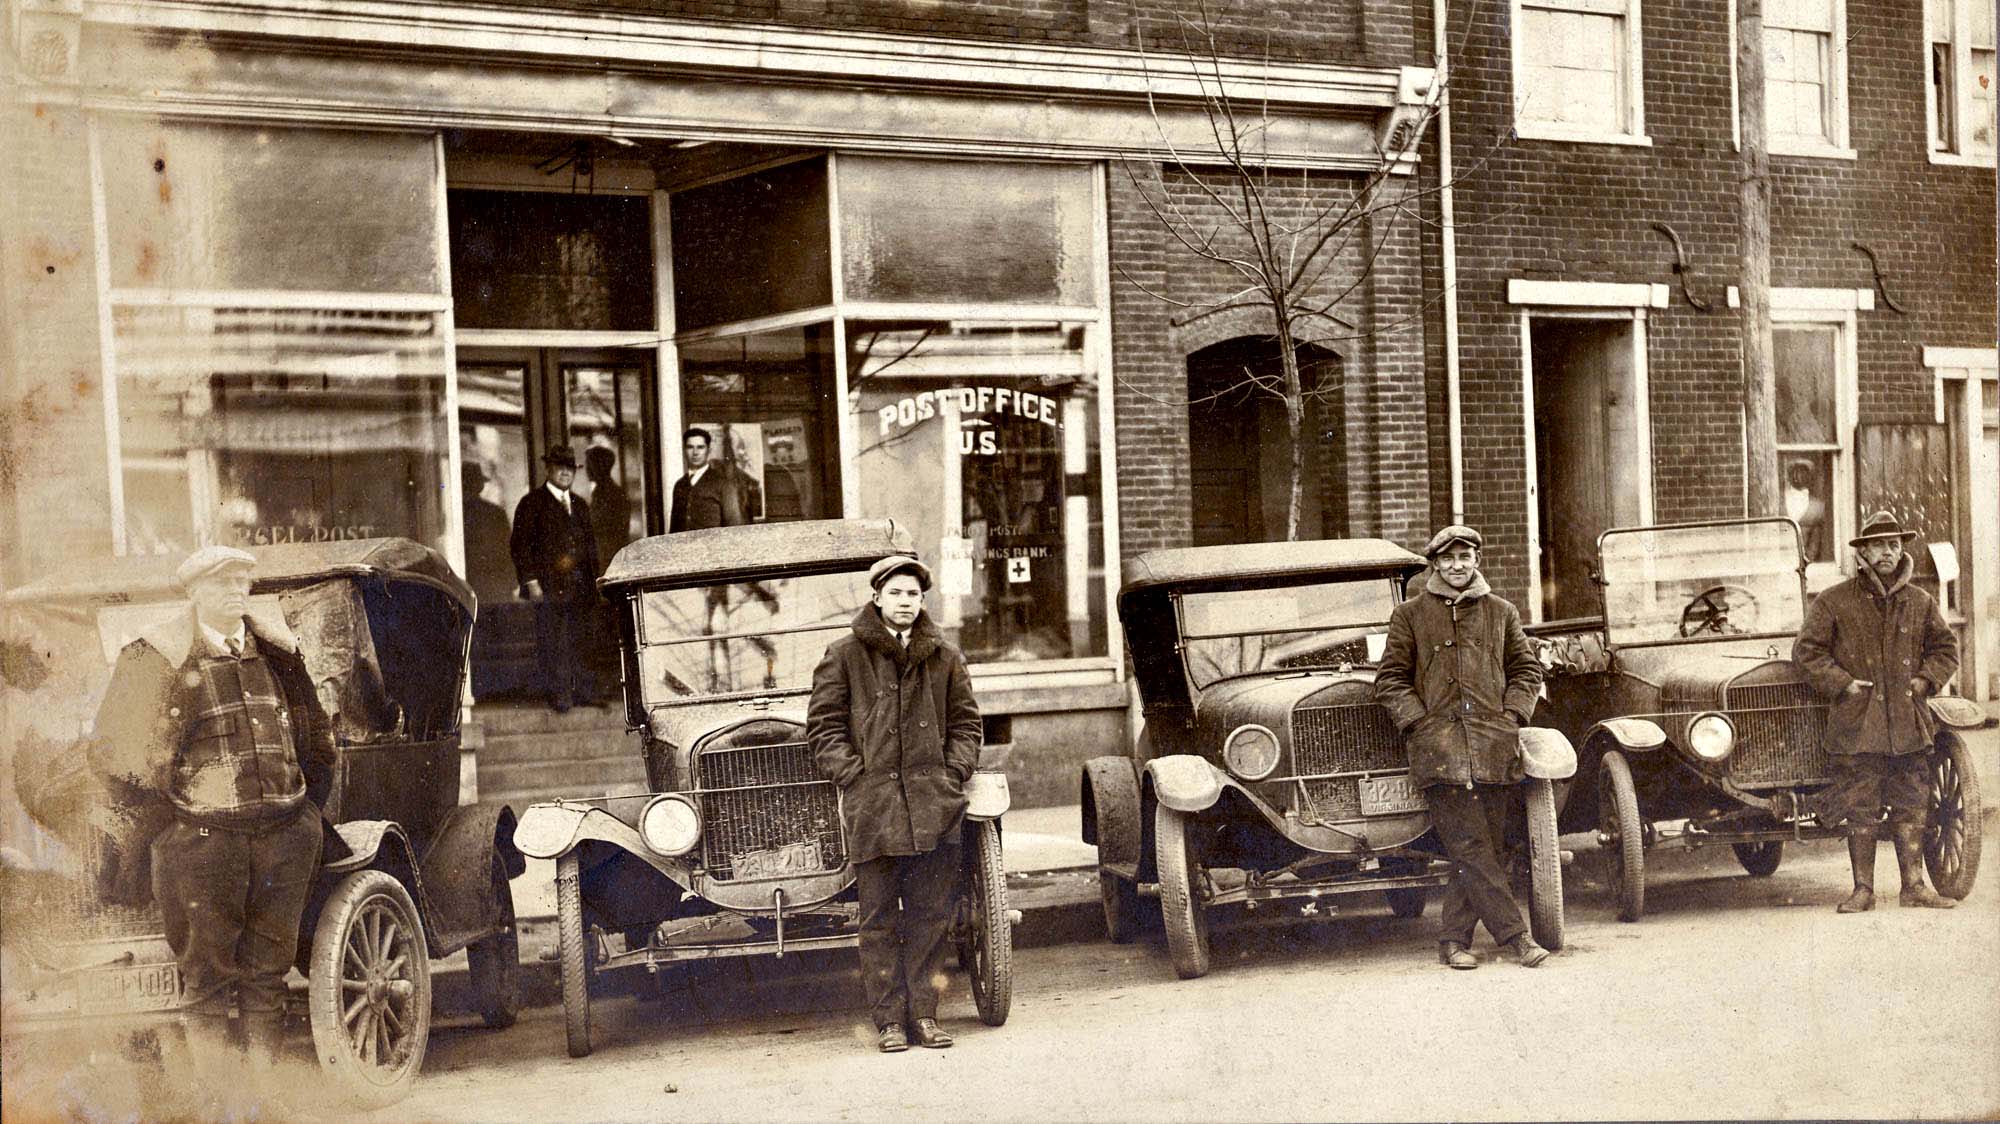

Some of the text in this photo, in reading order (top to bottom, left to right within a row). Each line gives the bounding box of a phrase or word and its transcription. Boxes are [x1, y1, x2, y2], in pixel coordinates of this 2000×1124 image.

[879, 389, 951, 436] POST
[957, 430, 1002, 455] U.S.
[311, 525, 375, 543] POST
